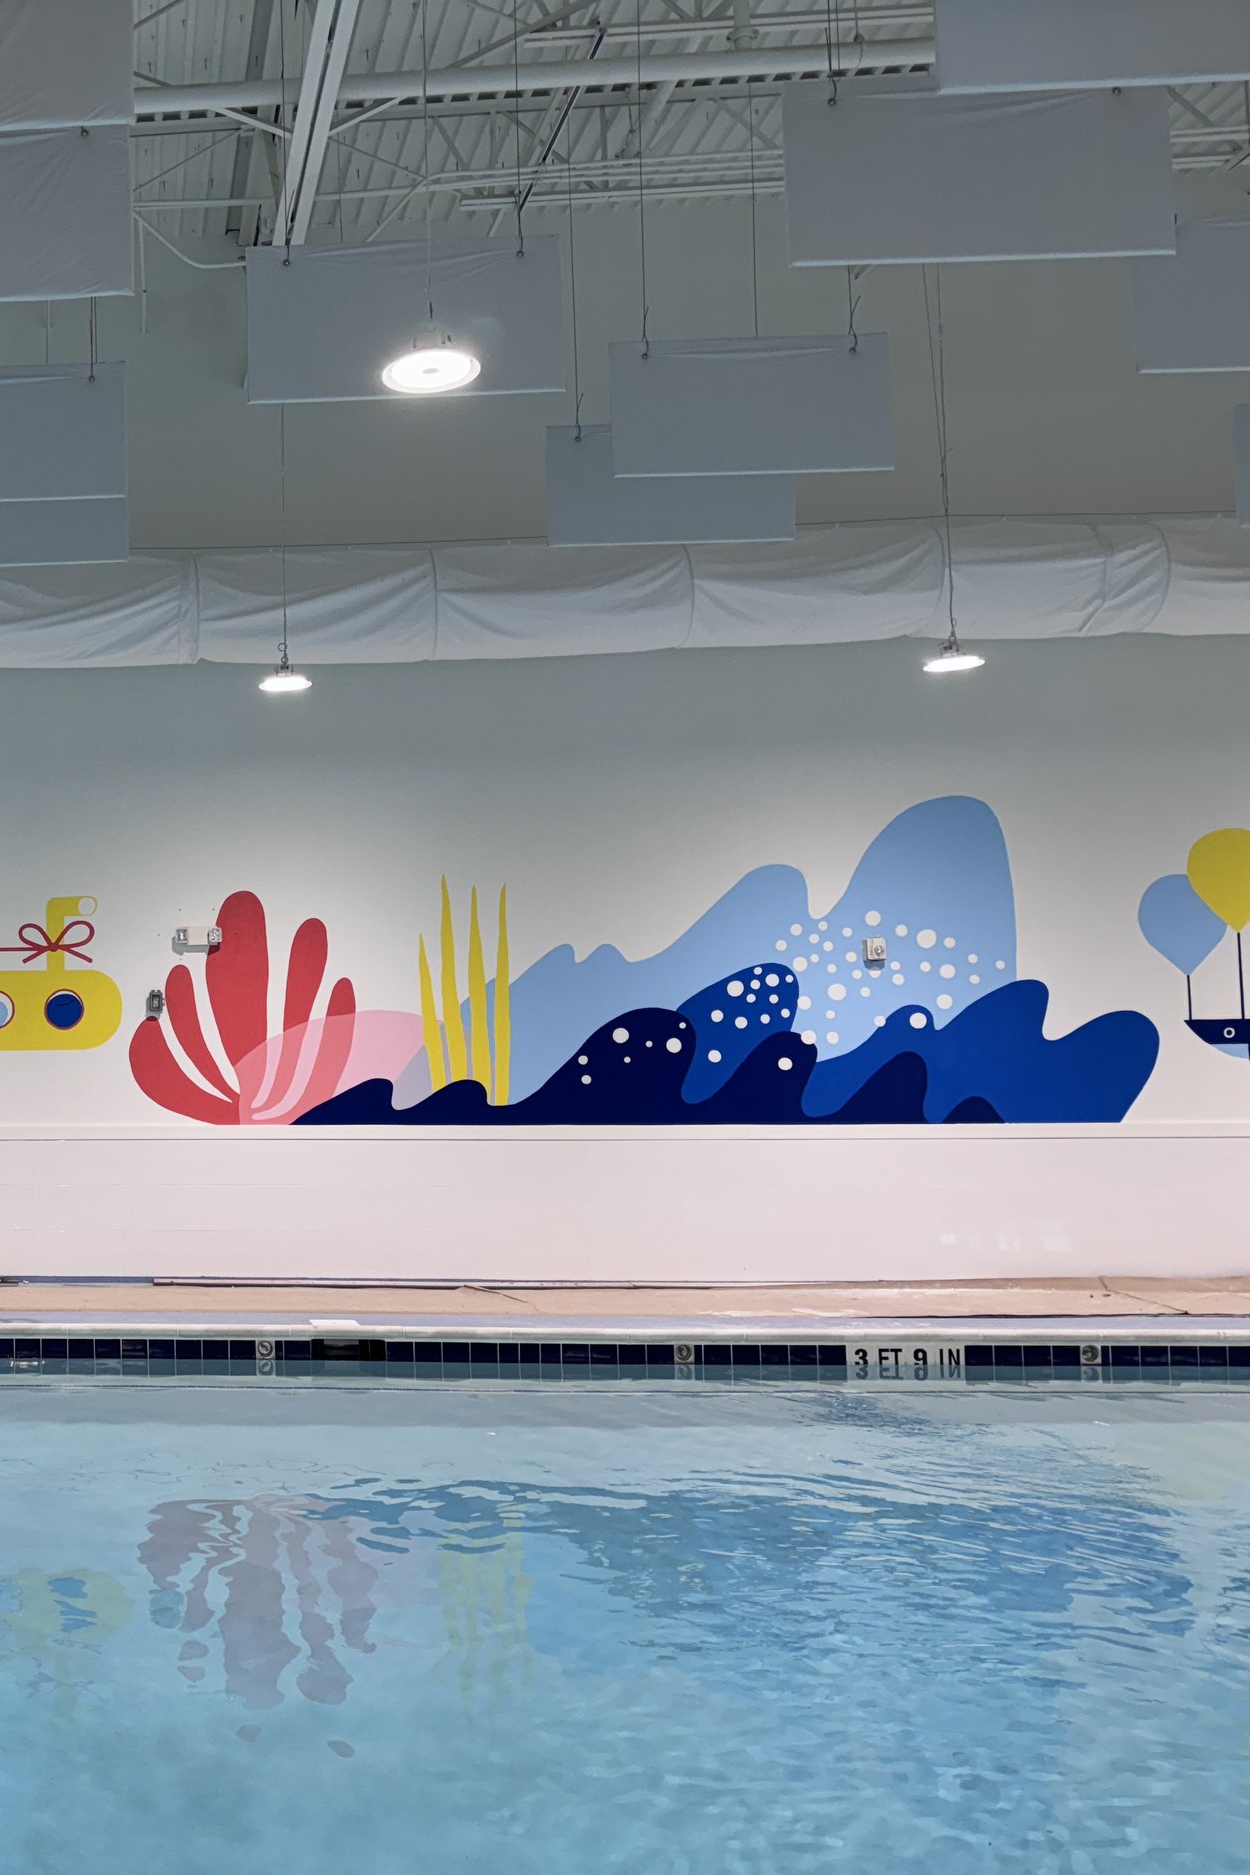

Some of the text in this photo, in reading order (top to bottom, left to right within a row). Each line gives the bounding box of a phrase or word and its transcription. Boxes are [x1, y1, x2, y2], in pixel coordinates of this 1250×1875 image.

[854, 1348, 961, 1366] 3 FT 9 IN
